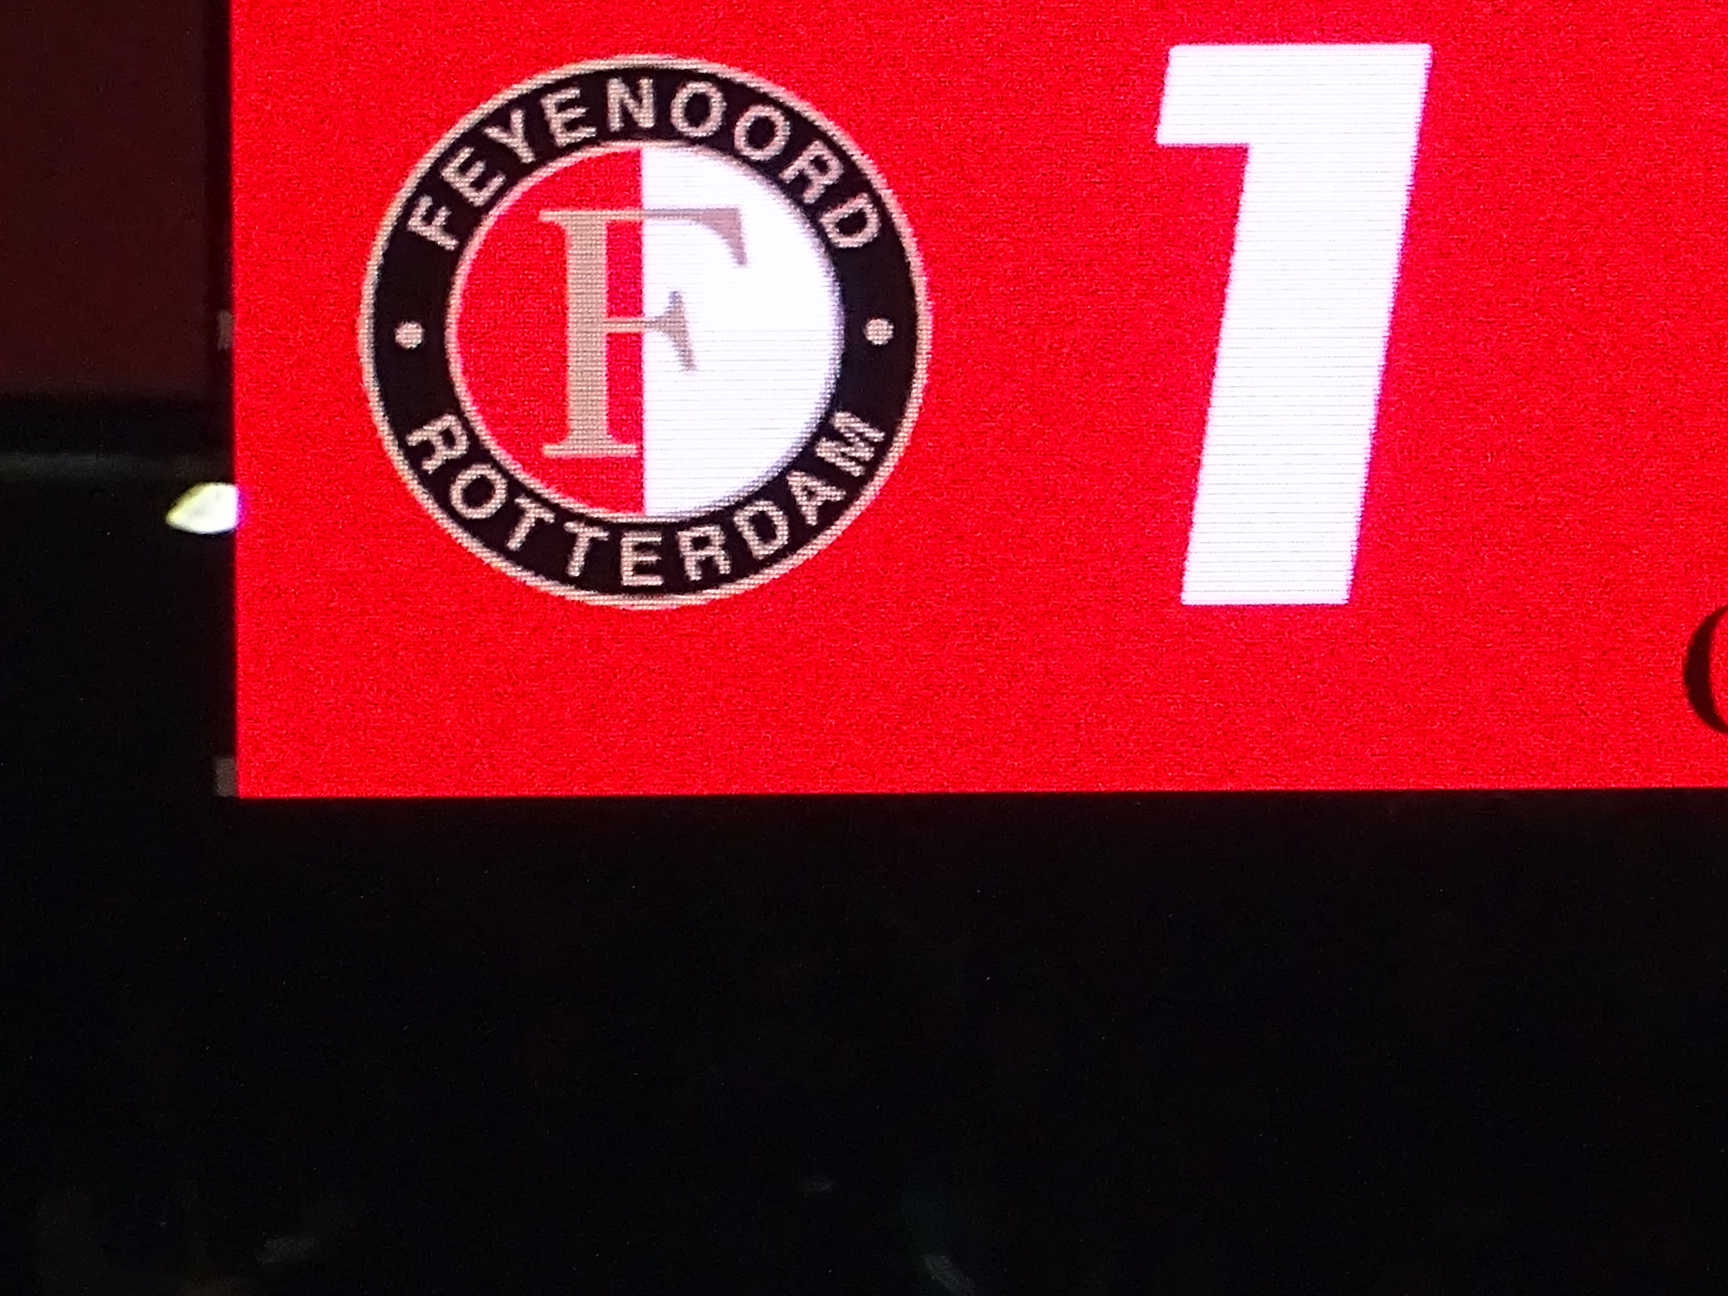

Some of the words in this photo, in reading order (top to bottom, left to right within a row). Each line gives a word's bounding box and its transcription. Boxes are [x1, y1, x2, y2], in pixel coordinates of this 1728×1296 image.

[406, 77, 883, 252] FEYENOORD
[538, 207, 750, 459] F
[1156, 43, 1432, 606] 1
[406, 410, 886, 587] ROTTERDAM
